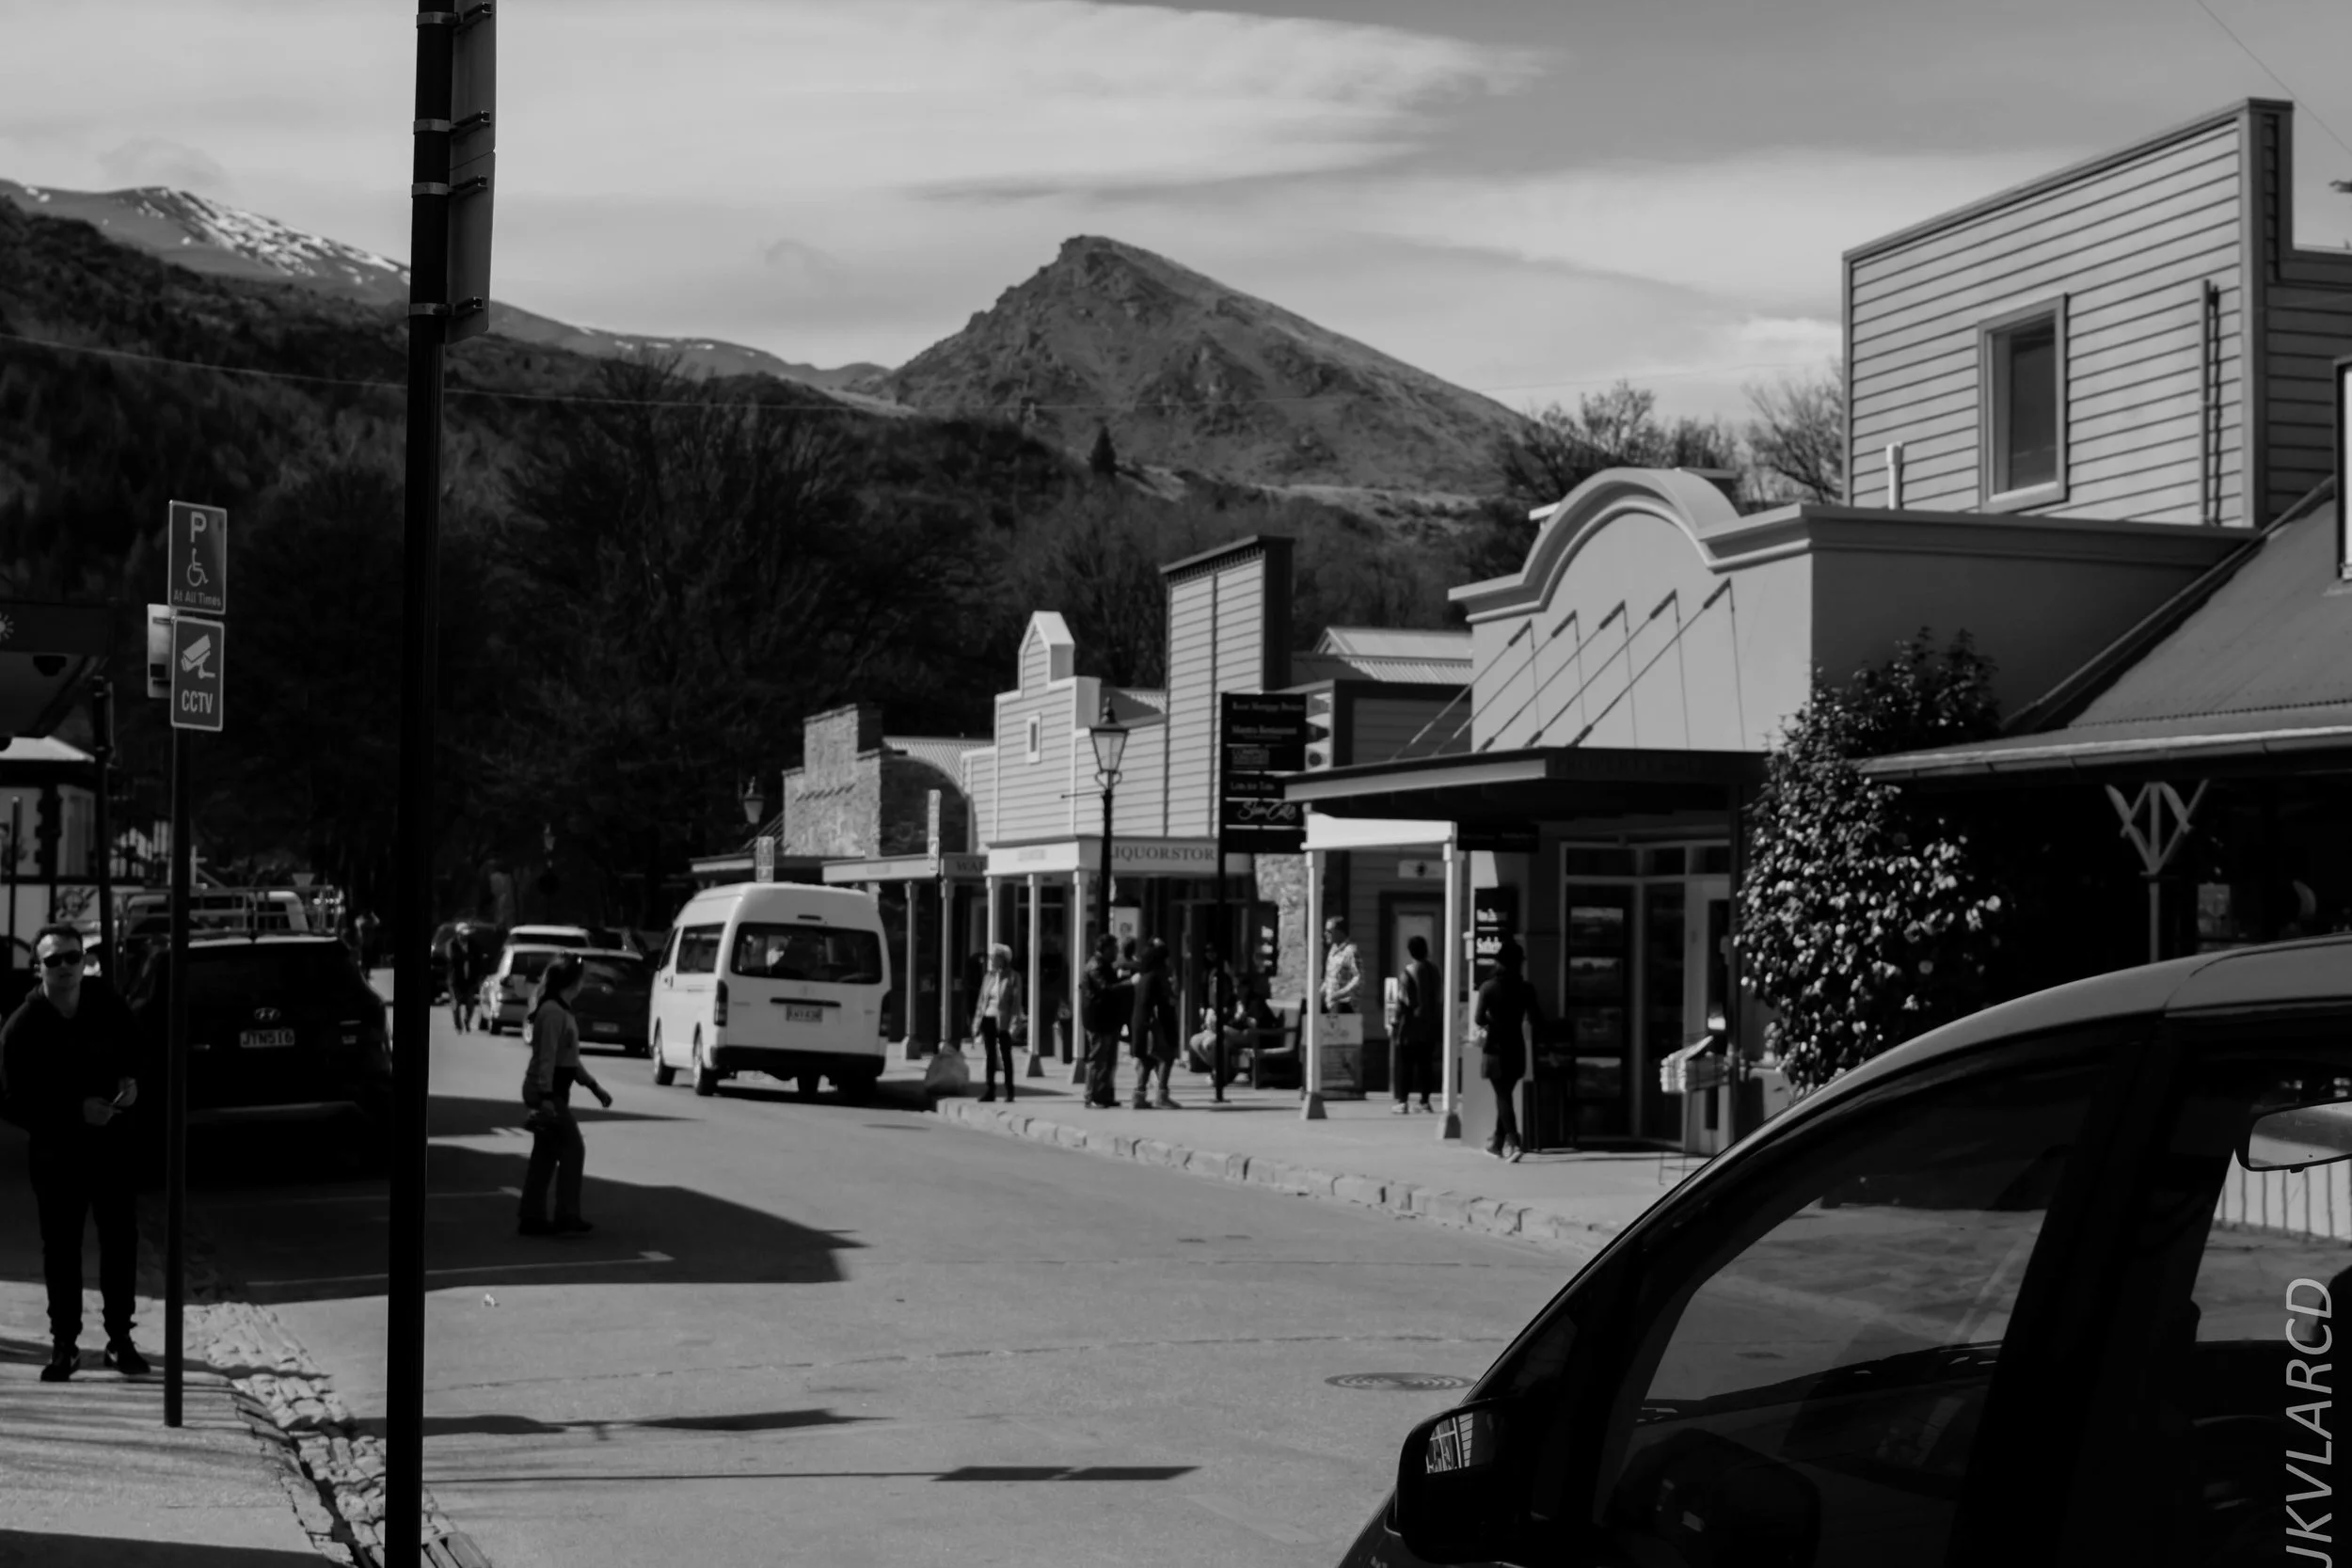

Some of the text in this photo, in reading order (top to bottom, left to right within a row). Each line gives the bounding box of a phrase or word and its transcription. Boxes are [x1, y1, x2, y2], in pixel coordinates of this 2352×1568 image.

[190, 511, 207, 543] P
[173, 589, 222, 608] At All Times
[181, 689, 214, 715] CCTV
[1111, 846, 1216, 863] IQUORSTOR
